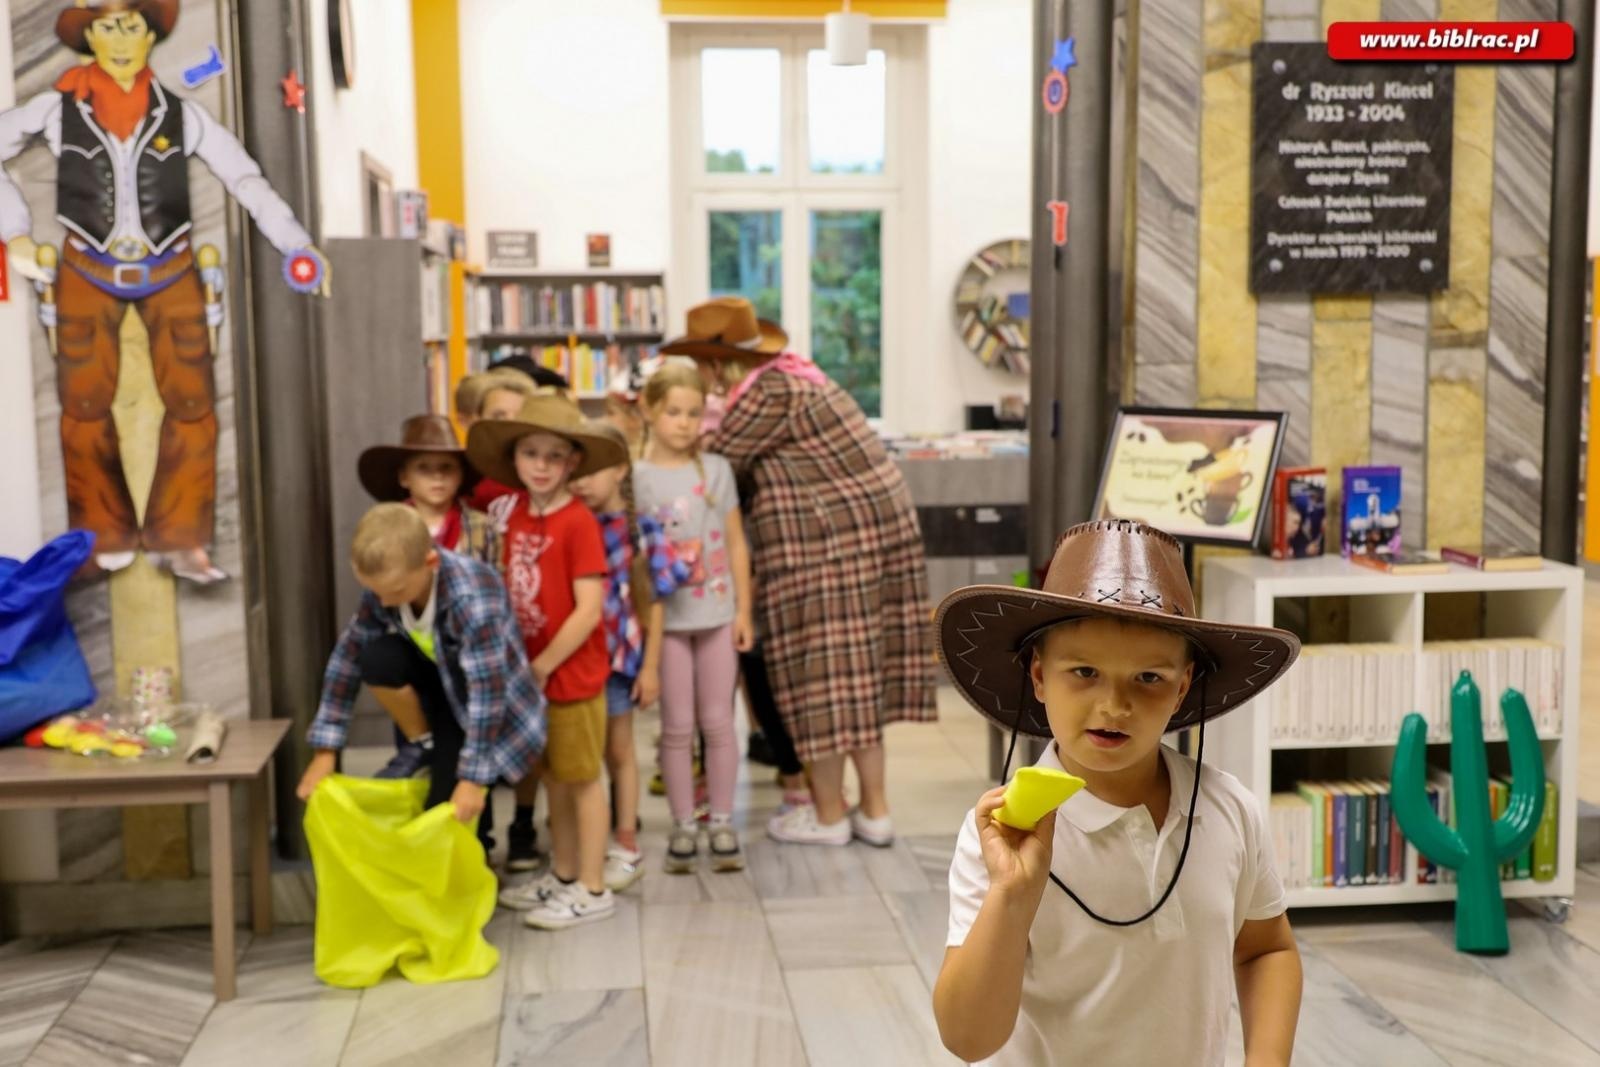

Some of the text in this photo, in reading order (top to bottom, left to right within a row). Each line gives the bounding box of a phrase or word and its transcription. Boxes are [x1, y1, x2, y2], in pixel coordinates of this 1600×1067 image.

[1282, 82, 1433, 102] dr Ryszard Kincel
[1306, 104, 1344, 122] 1933
[1359, 104, 1405, 122] 2004
